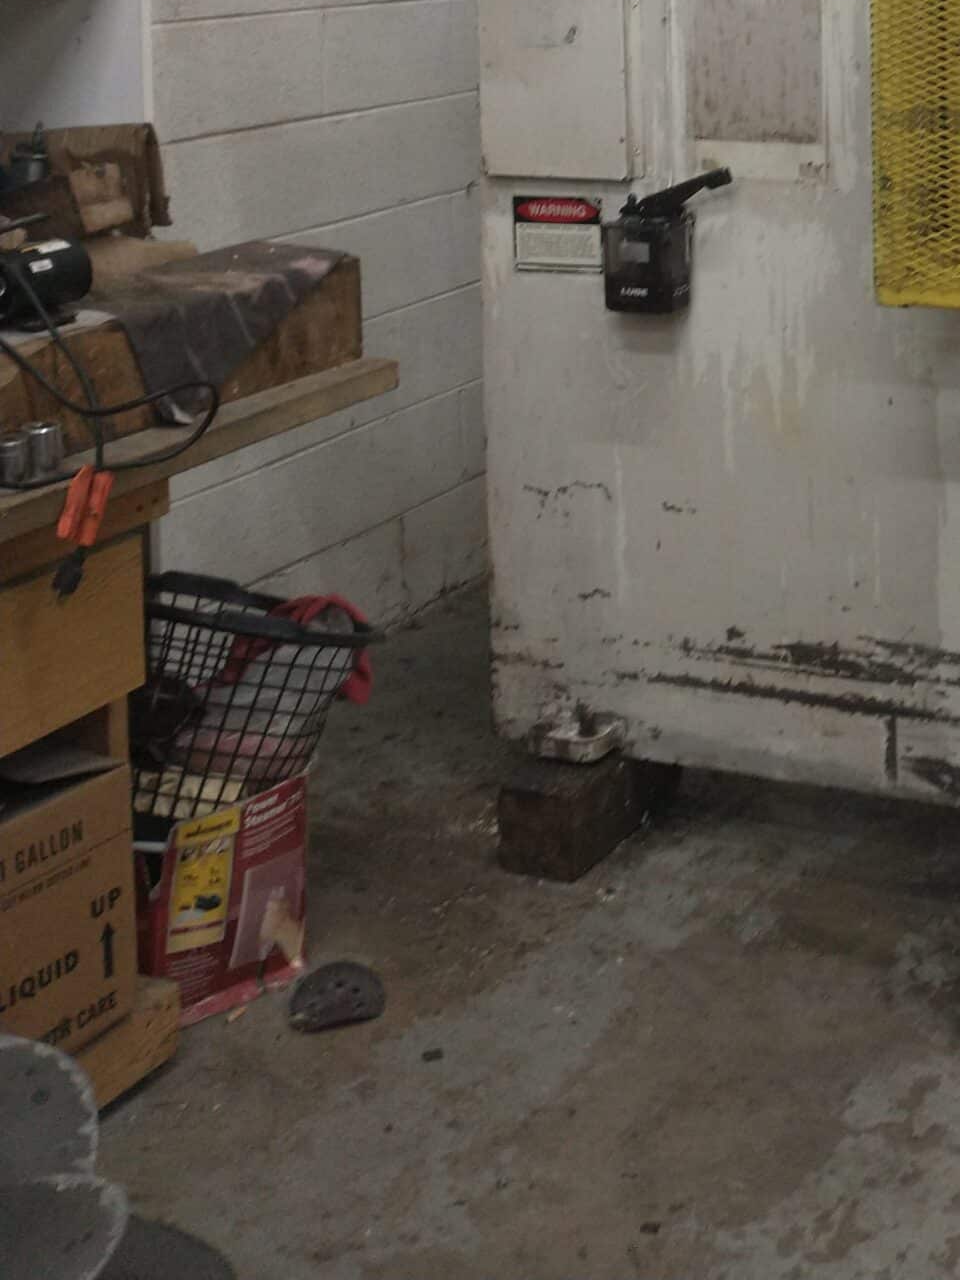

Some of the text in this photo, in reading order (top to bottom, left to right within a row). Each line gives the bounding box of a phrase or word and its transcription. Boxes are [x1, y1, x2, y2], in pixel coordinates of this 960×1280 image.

[528, 202, 586, 218] WARNING
[15, 818, 85, 874] GALLON
[90, 886, 122, 919] UP
[0, 948, 80, 1014] LIQUID
[76, 991, 119, 1030] CARE
